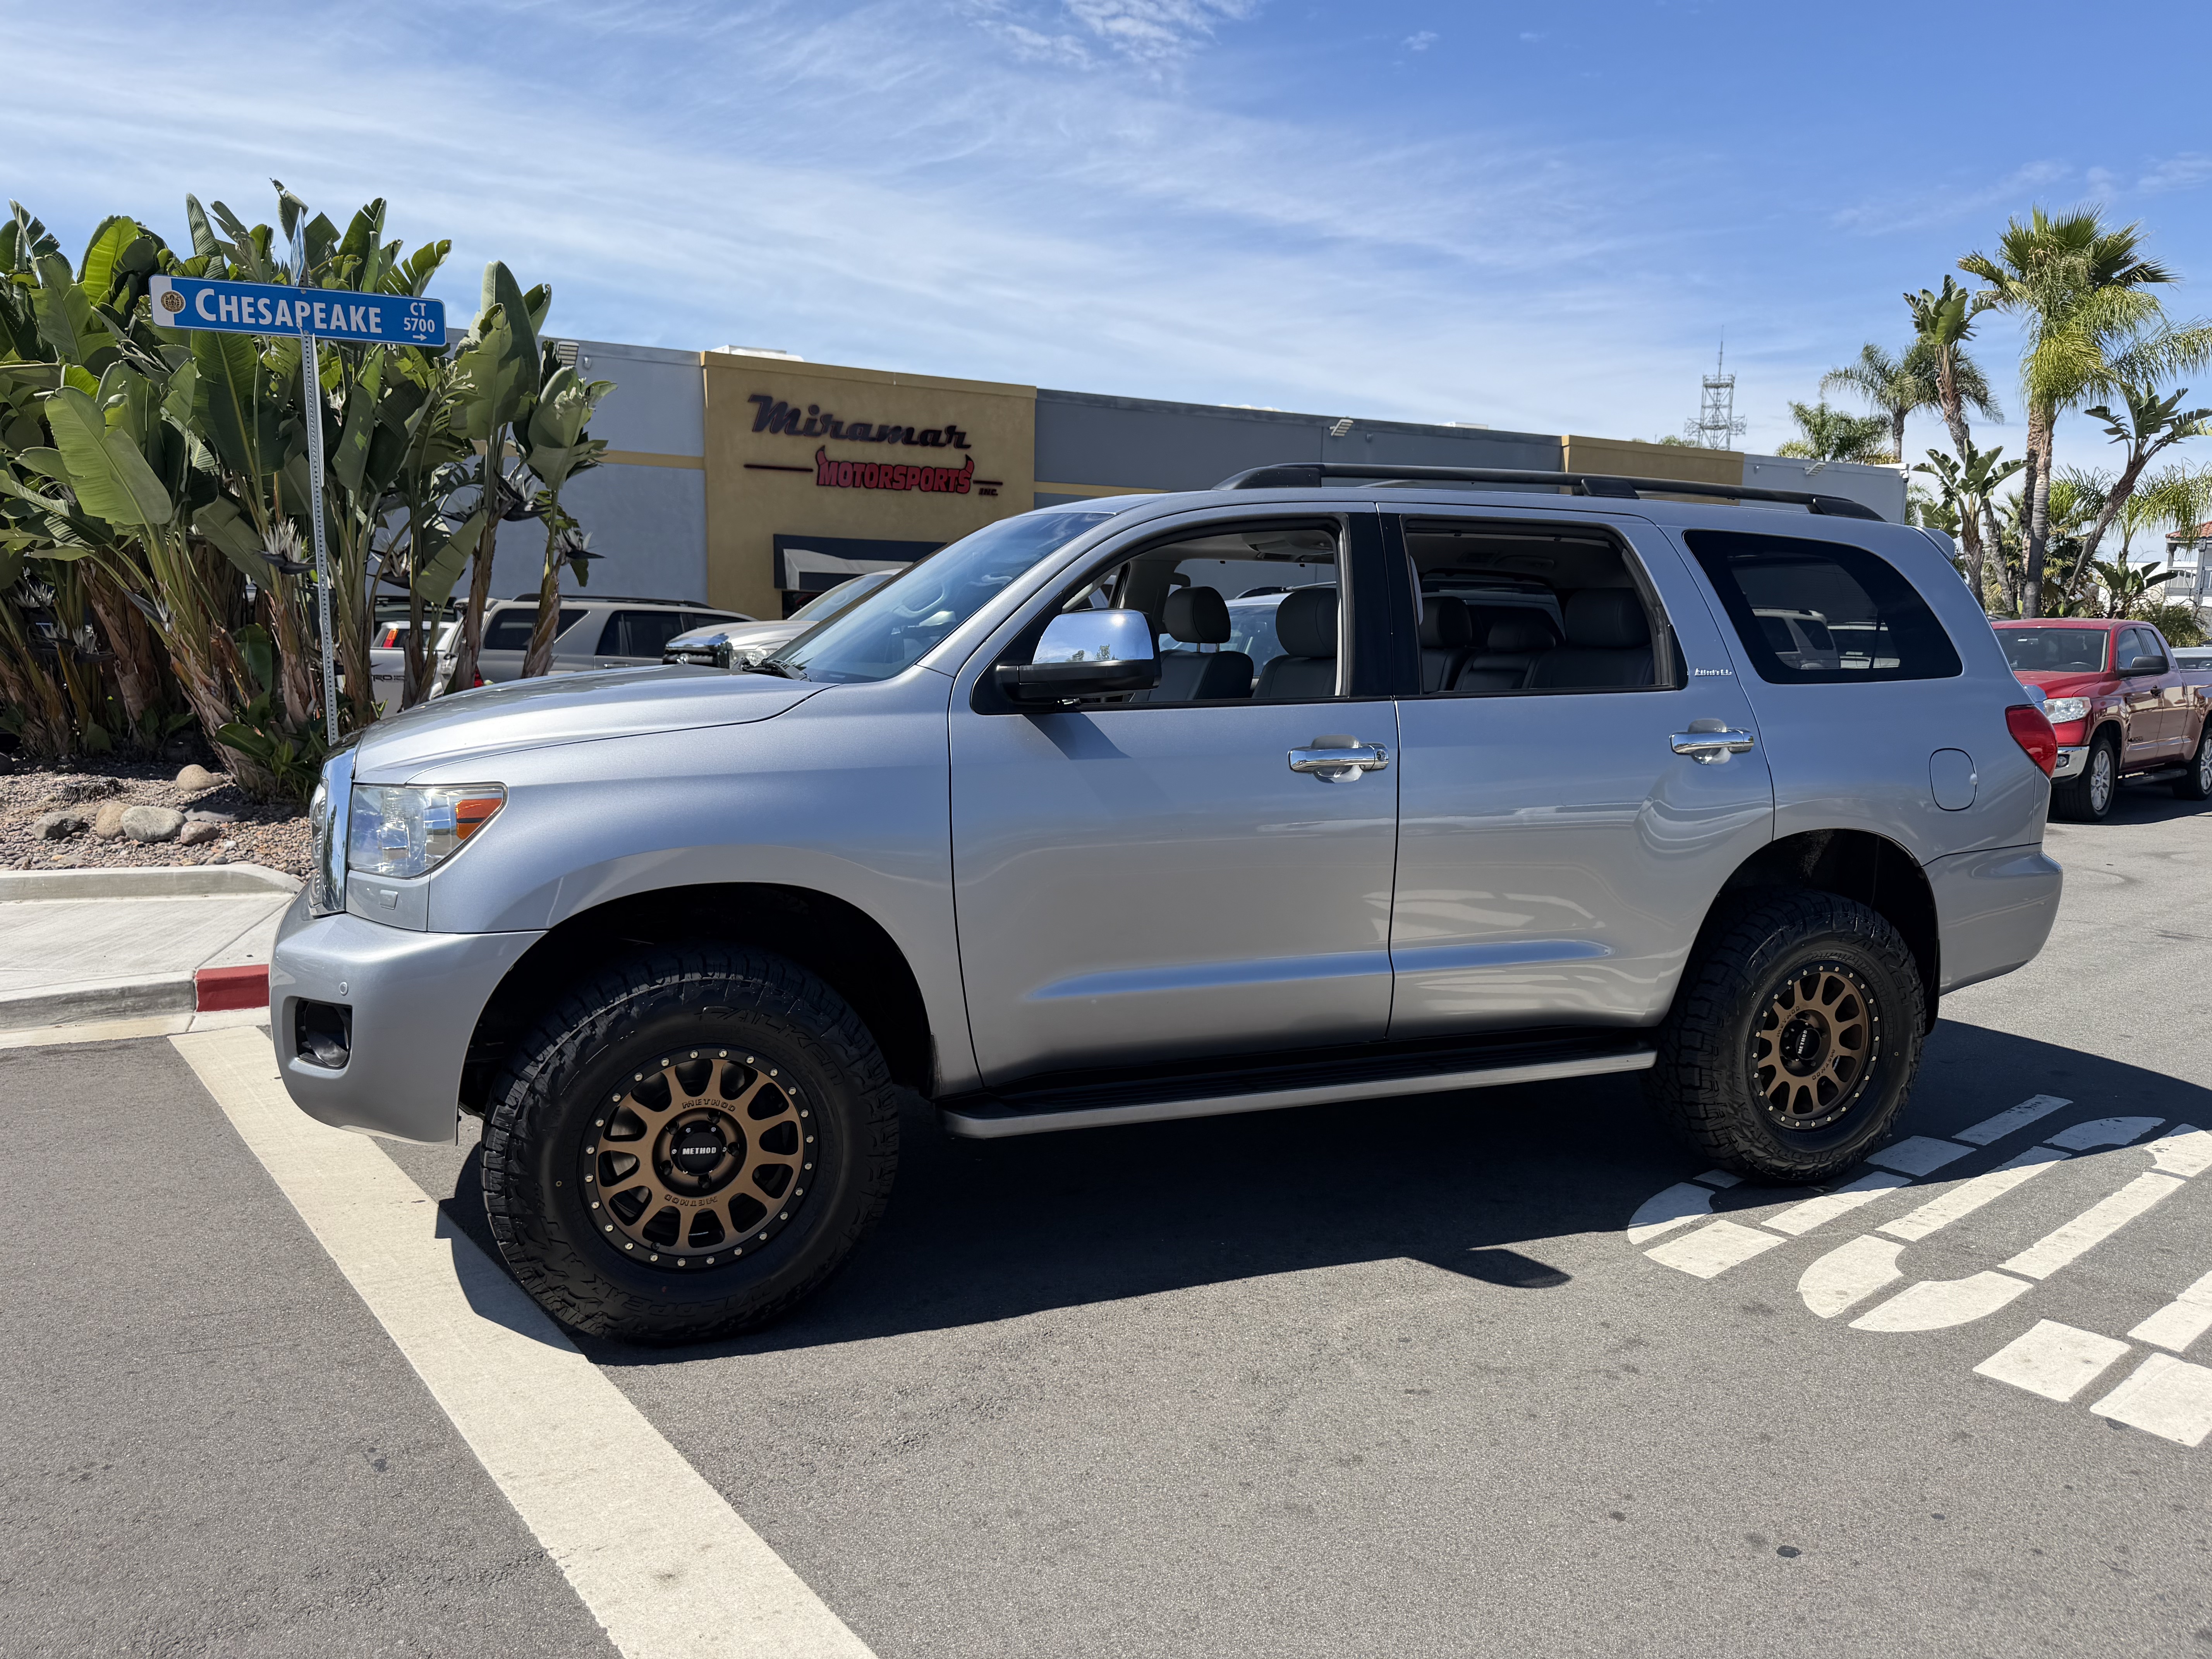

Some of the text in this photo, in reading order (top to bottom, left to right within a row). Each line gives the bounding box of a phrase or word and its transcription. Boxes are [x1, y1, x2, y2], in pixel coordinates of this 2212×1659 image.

[195, 288, 383, 333] CHESAPEAKE
[410, 302, 426, 316] CT
[403, 317, 435, 333] 5700
[748, 395, 971, 448] Miramar
[816, 459, 973, 494] MOTORSPORTS
[978, 488, 999, 496] INC.
[1797, 1030, 1807, 1054] METHOD
[682, 1098, 736, 1112] METHOD
[682, 1147, 717, 1155] METHOD
[664, 1194, 718, 1206] METHOD
